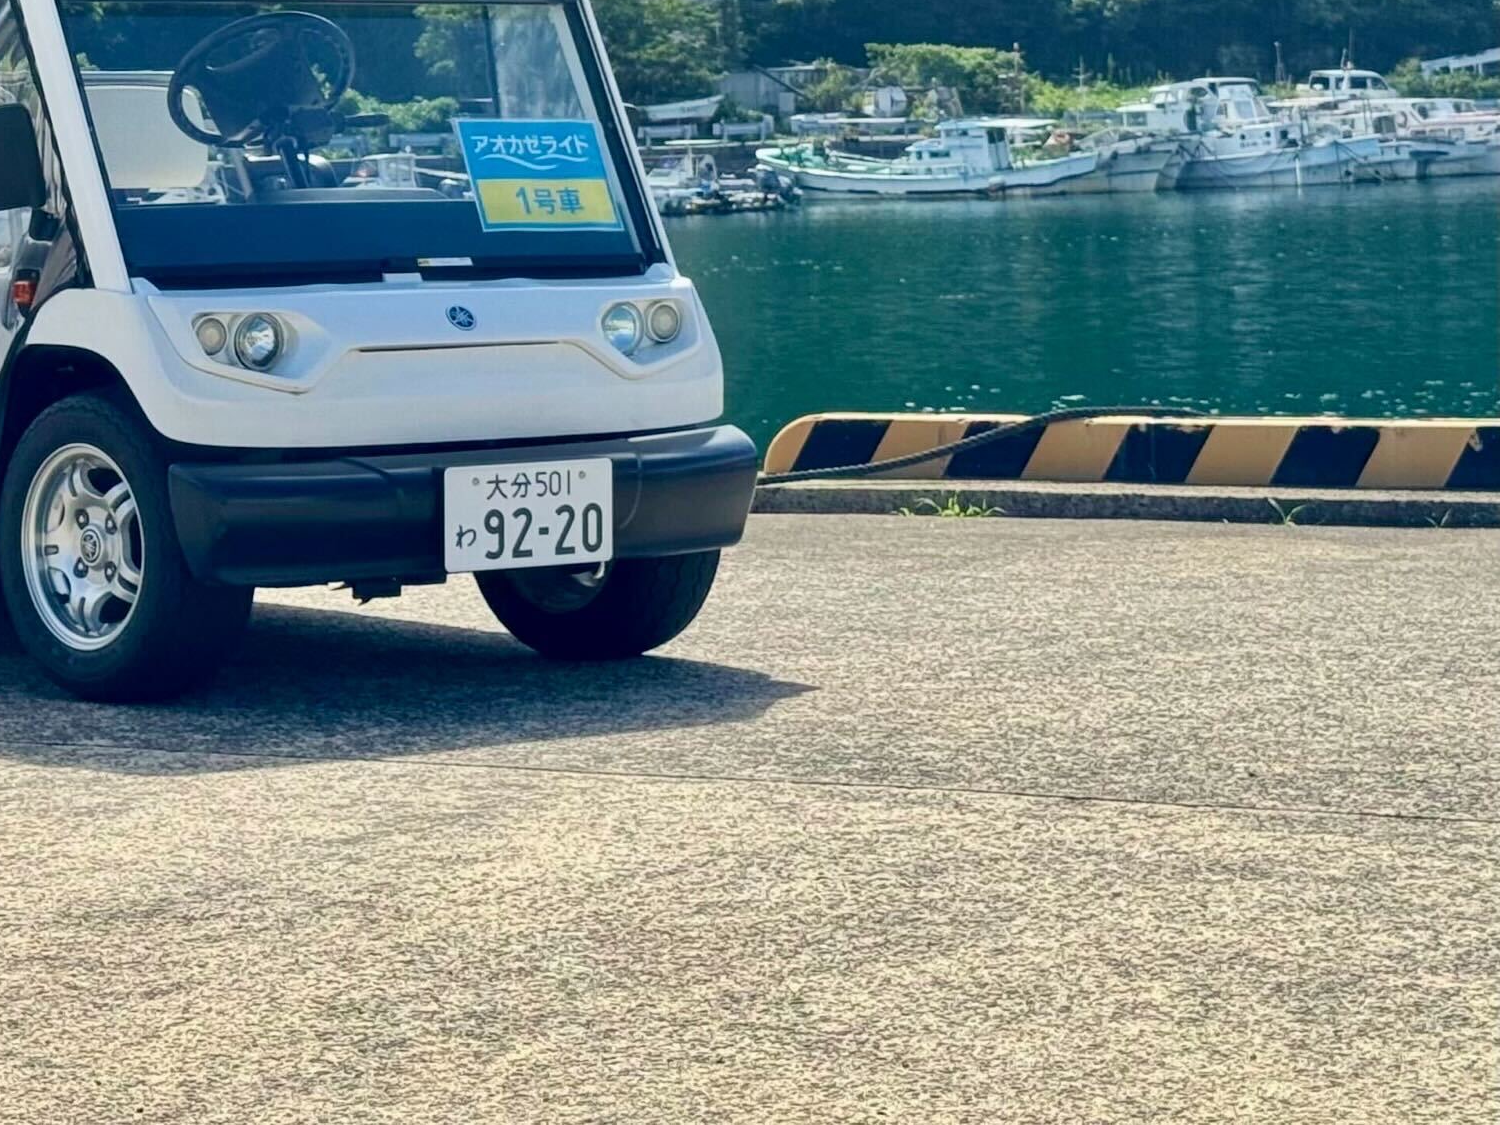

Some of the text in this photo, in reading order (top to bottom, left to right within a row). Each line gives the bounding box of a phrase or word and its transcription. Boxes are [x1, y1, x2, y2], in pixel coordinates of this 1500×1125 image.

[470, 135, 589, 155] アオカゼライド
[516, 186, 582, 216] 1号車
[455, 502, 603, 559] わ 92-20
